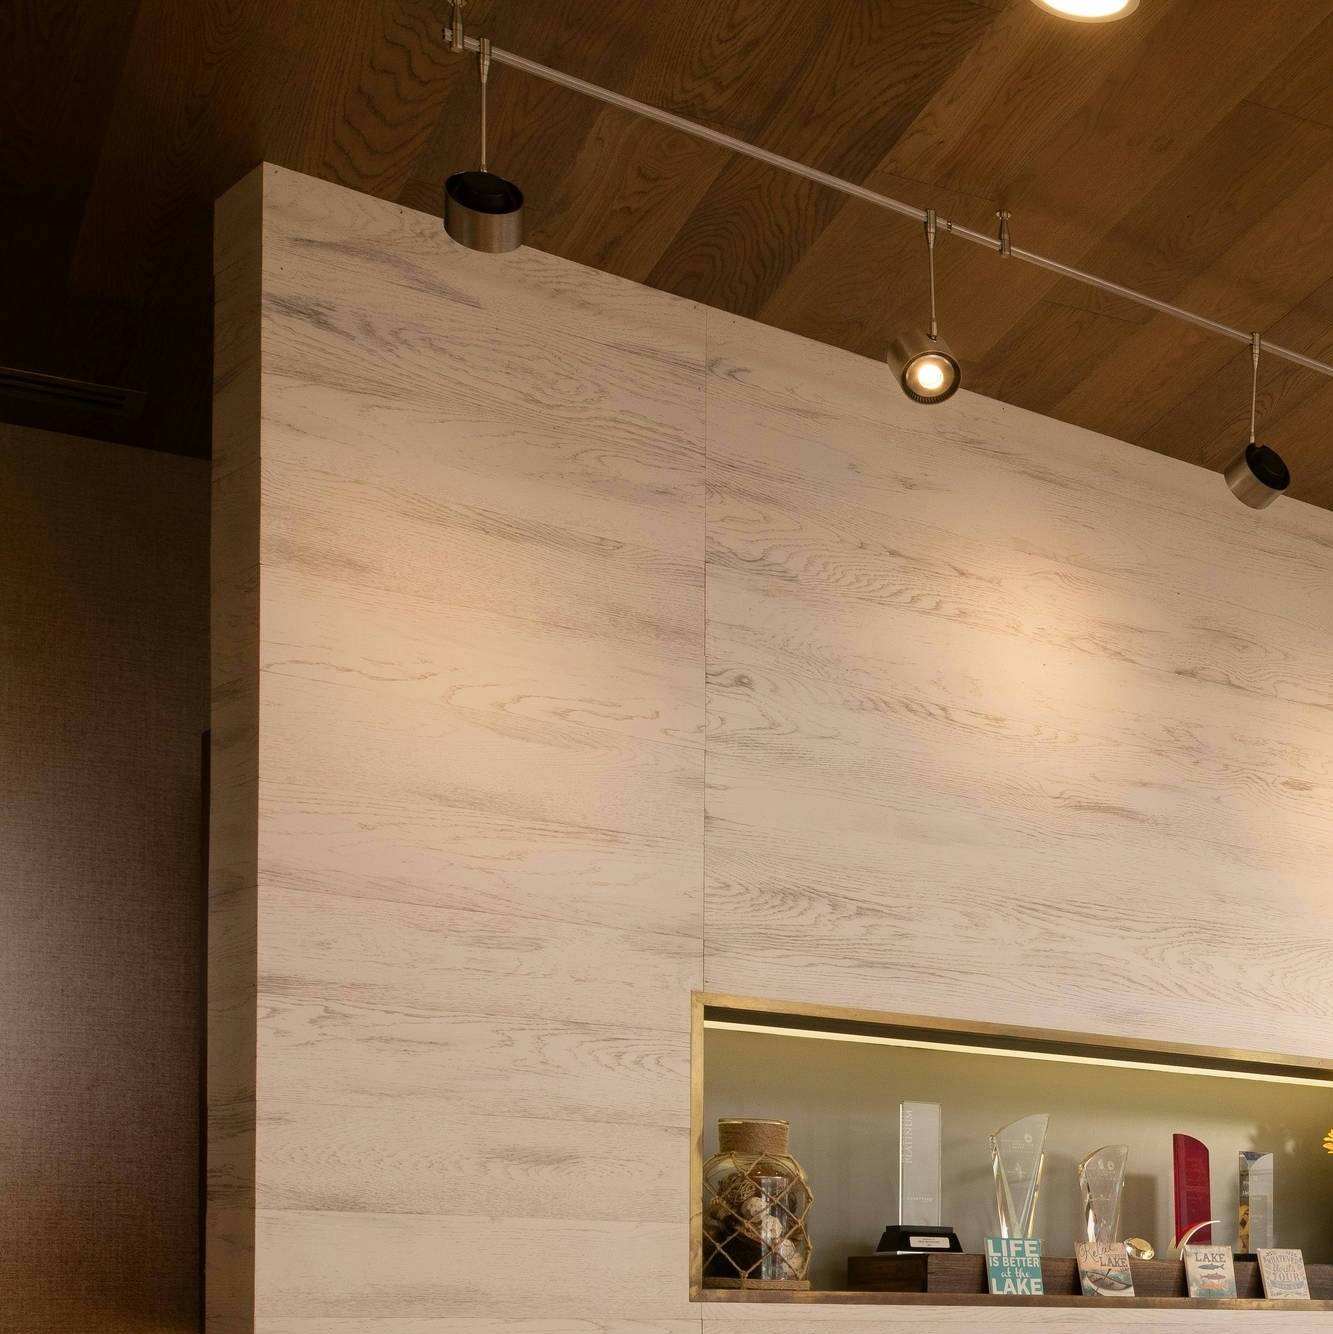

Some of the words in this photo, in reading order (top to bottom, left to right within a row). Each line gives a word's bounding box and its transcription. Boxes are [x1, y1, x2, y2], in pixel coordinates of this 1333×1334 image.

[903, 1110, 913, 1164] PLATINUM
[988, 1239, 1039, 1257] LIFE
[989, 1256, 999, 1267] IS
[1002, 1256, 1040, 1268] BETTER
[1099, 1256, 1128, 1268] LAKE
[1195, 1252, 1226, 1263] LAKE
[1000, 1267, 1011, 1278] at
[1015, 1267, 1031, 1279] the
[991, 1277, 1044, 1295] LAKE
